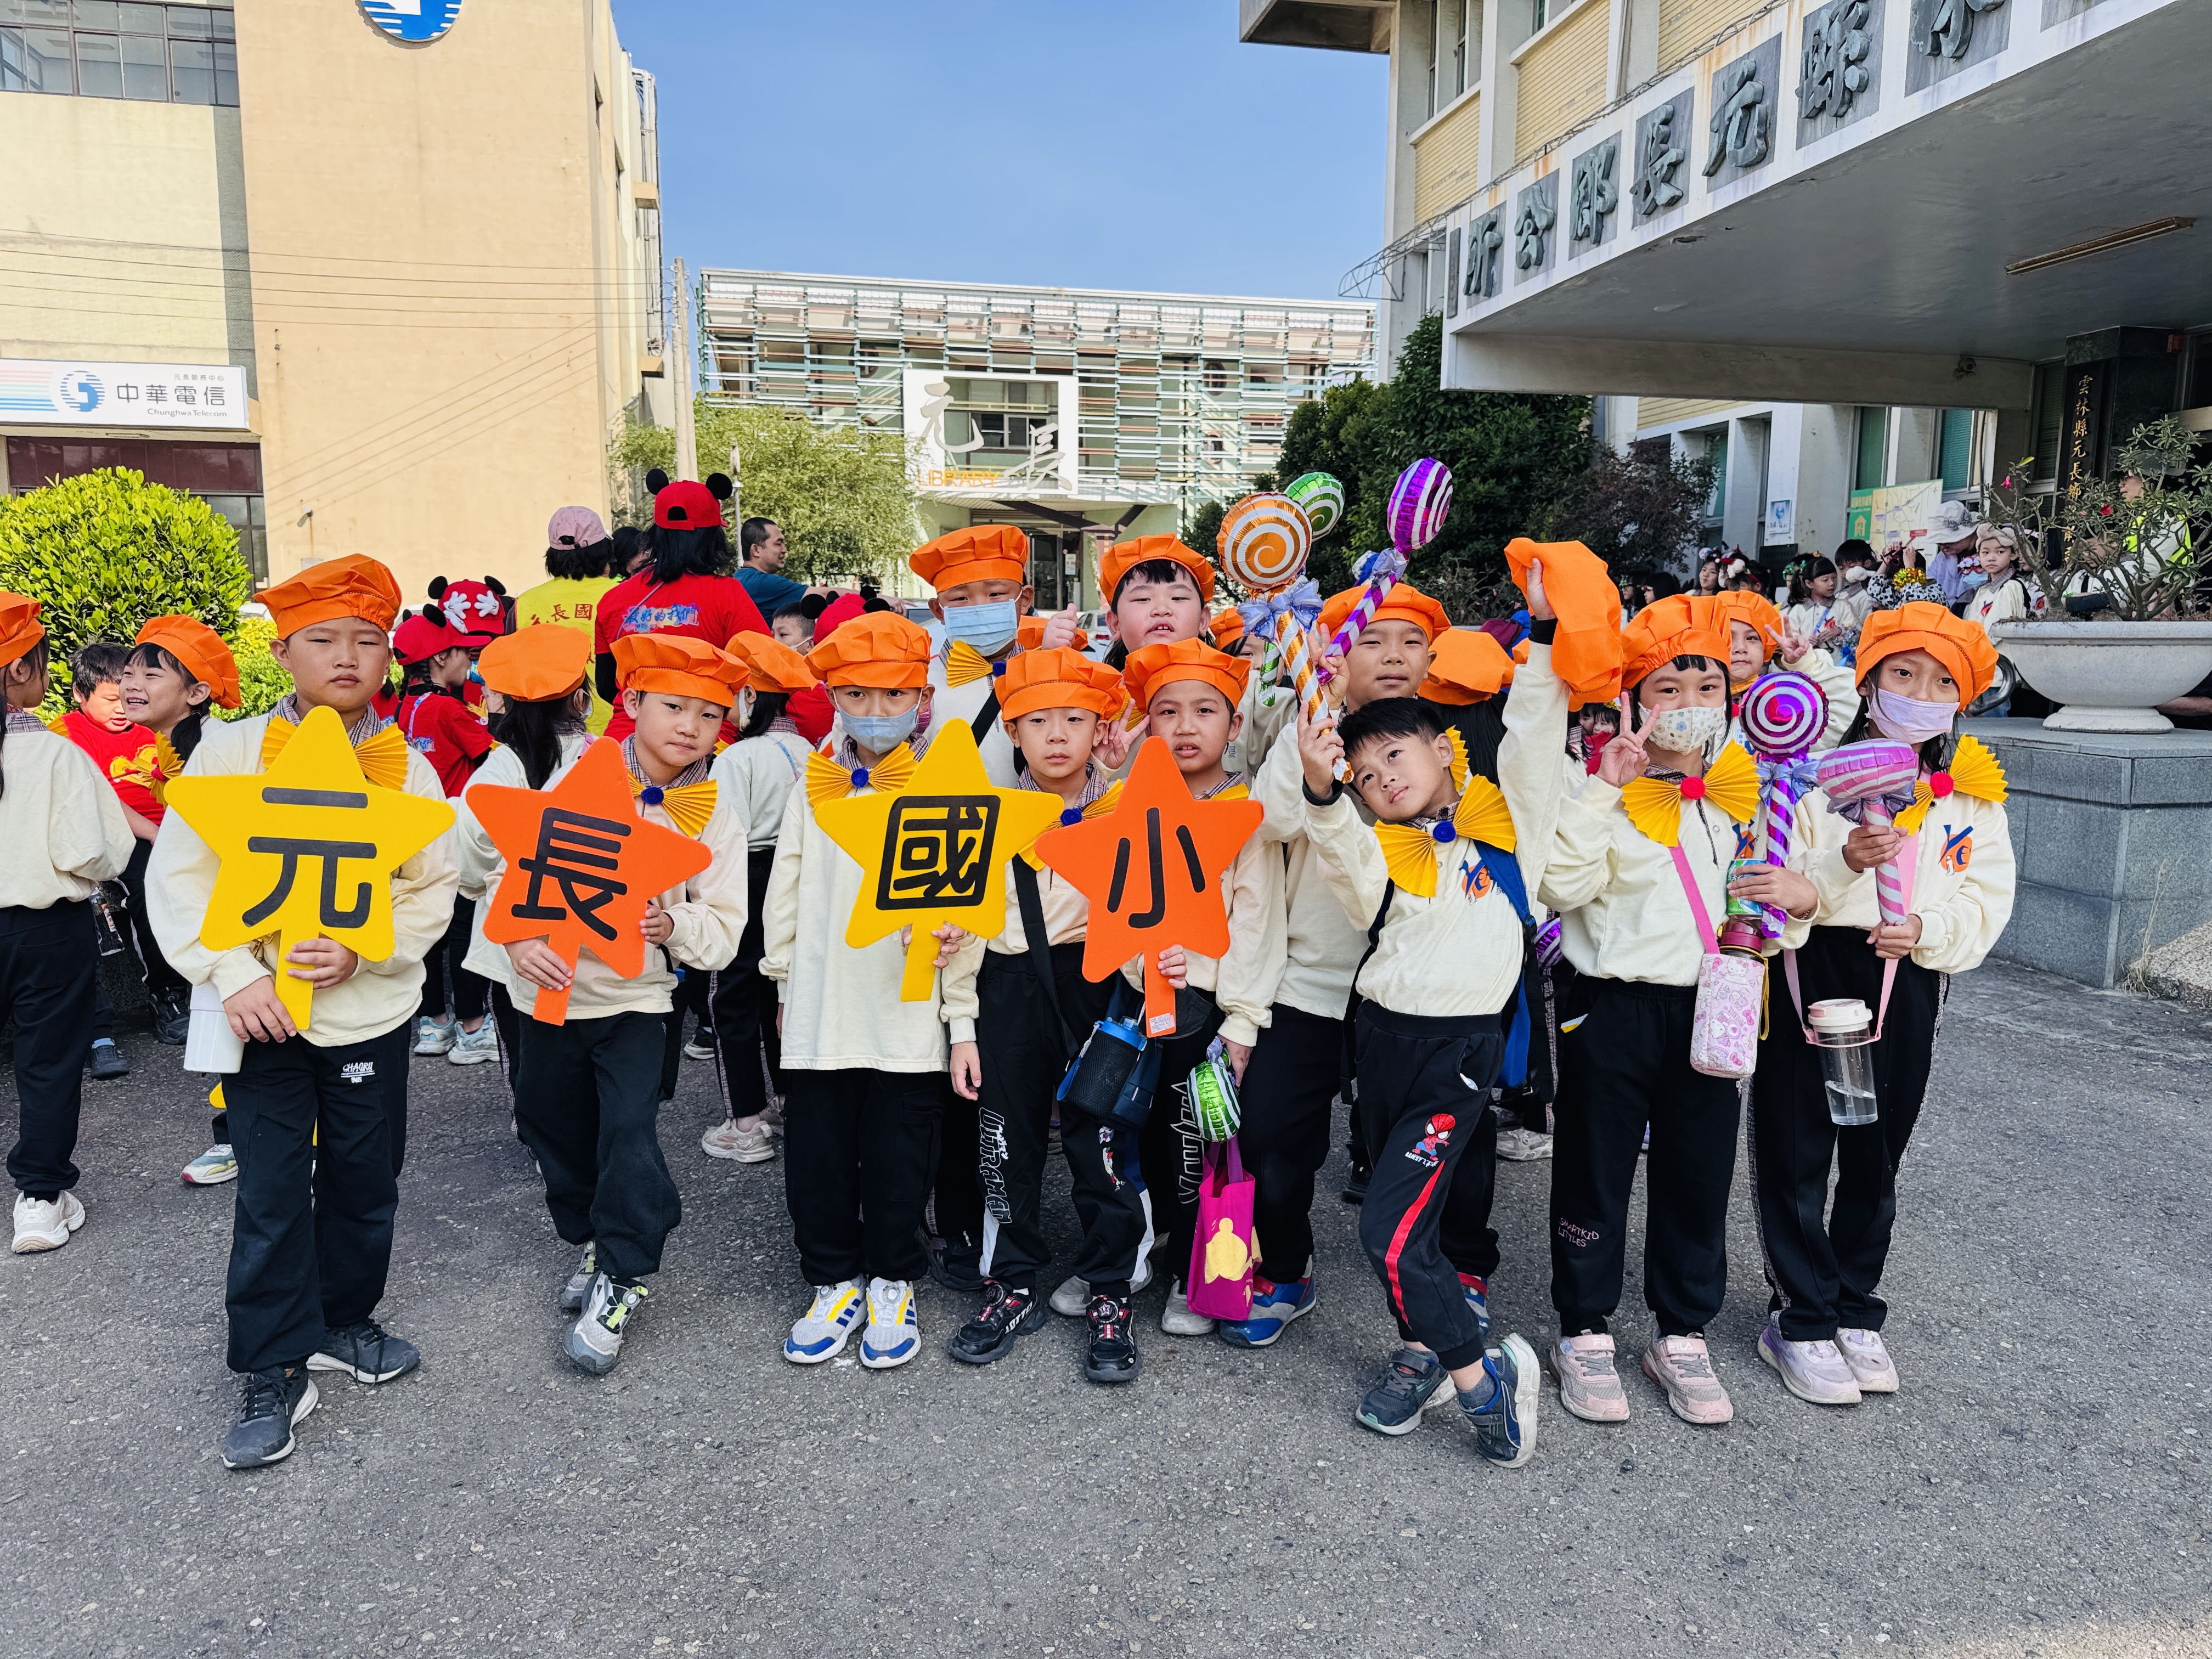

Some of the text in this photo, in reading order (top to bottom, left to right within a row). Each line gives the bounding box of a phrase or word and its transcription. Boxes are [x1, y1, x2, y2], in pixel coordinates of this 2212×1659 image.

[117, 383, 225, 405] 中華電信
[147, 408, 191, 417] Chunghwa
[918, 470, 1000, 488] LIBRARY
[242, 787, 377, 928] 元
[876, 795, 1001, 911] 國
[512, 807, 632, 941] 長
[1107, 808, 1206, 928] 小
[1558, 1226, 1587, 1248] LITTLES
[1559, 1217, 1600, 1240] SMARTKID
[1667, 1342, 1694, 1351] FILA
